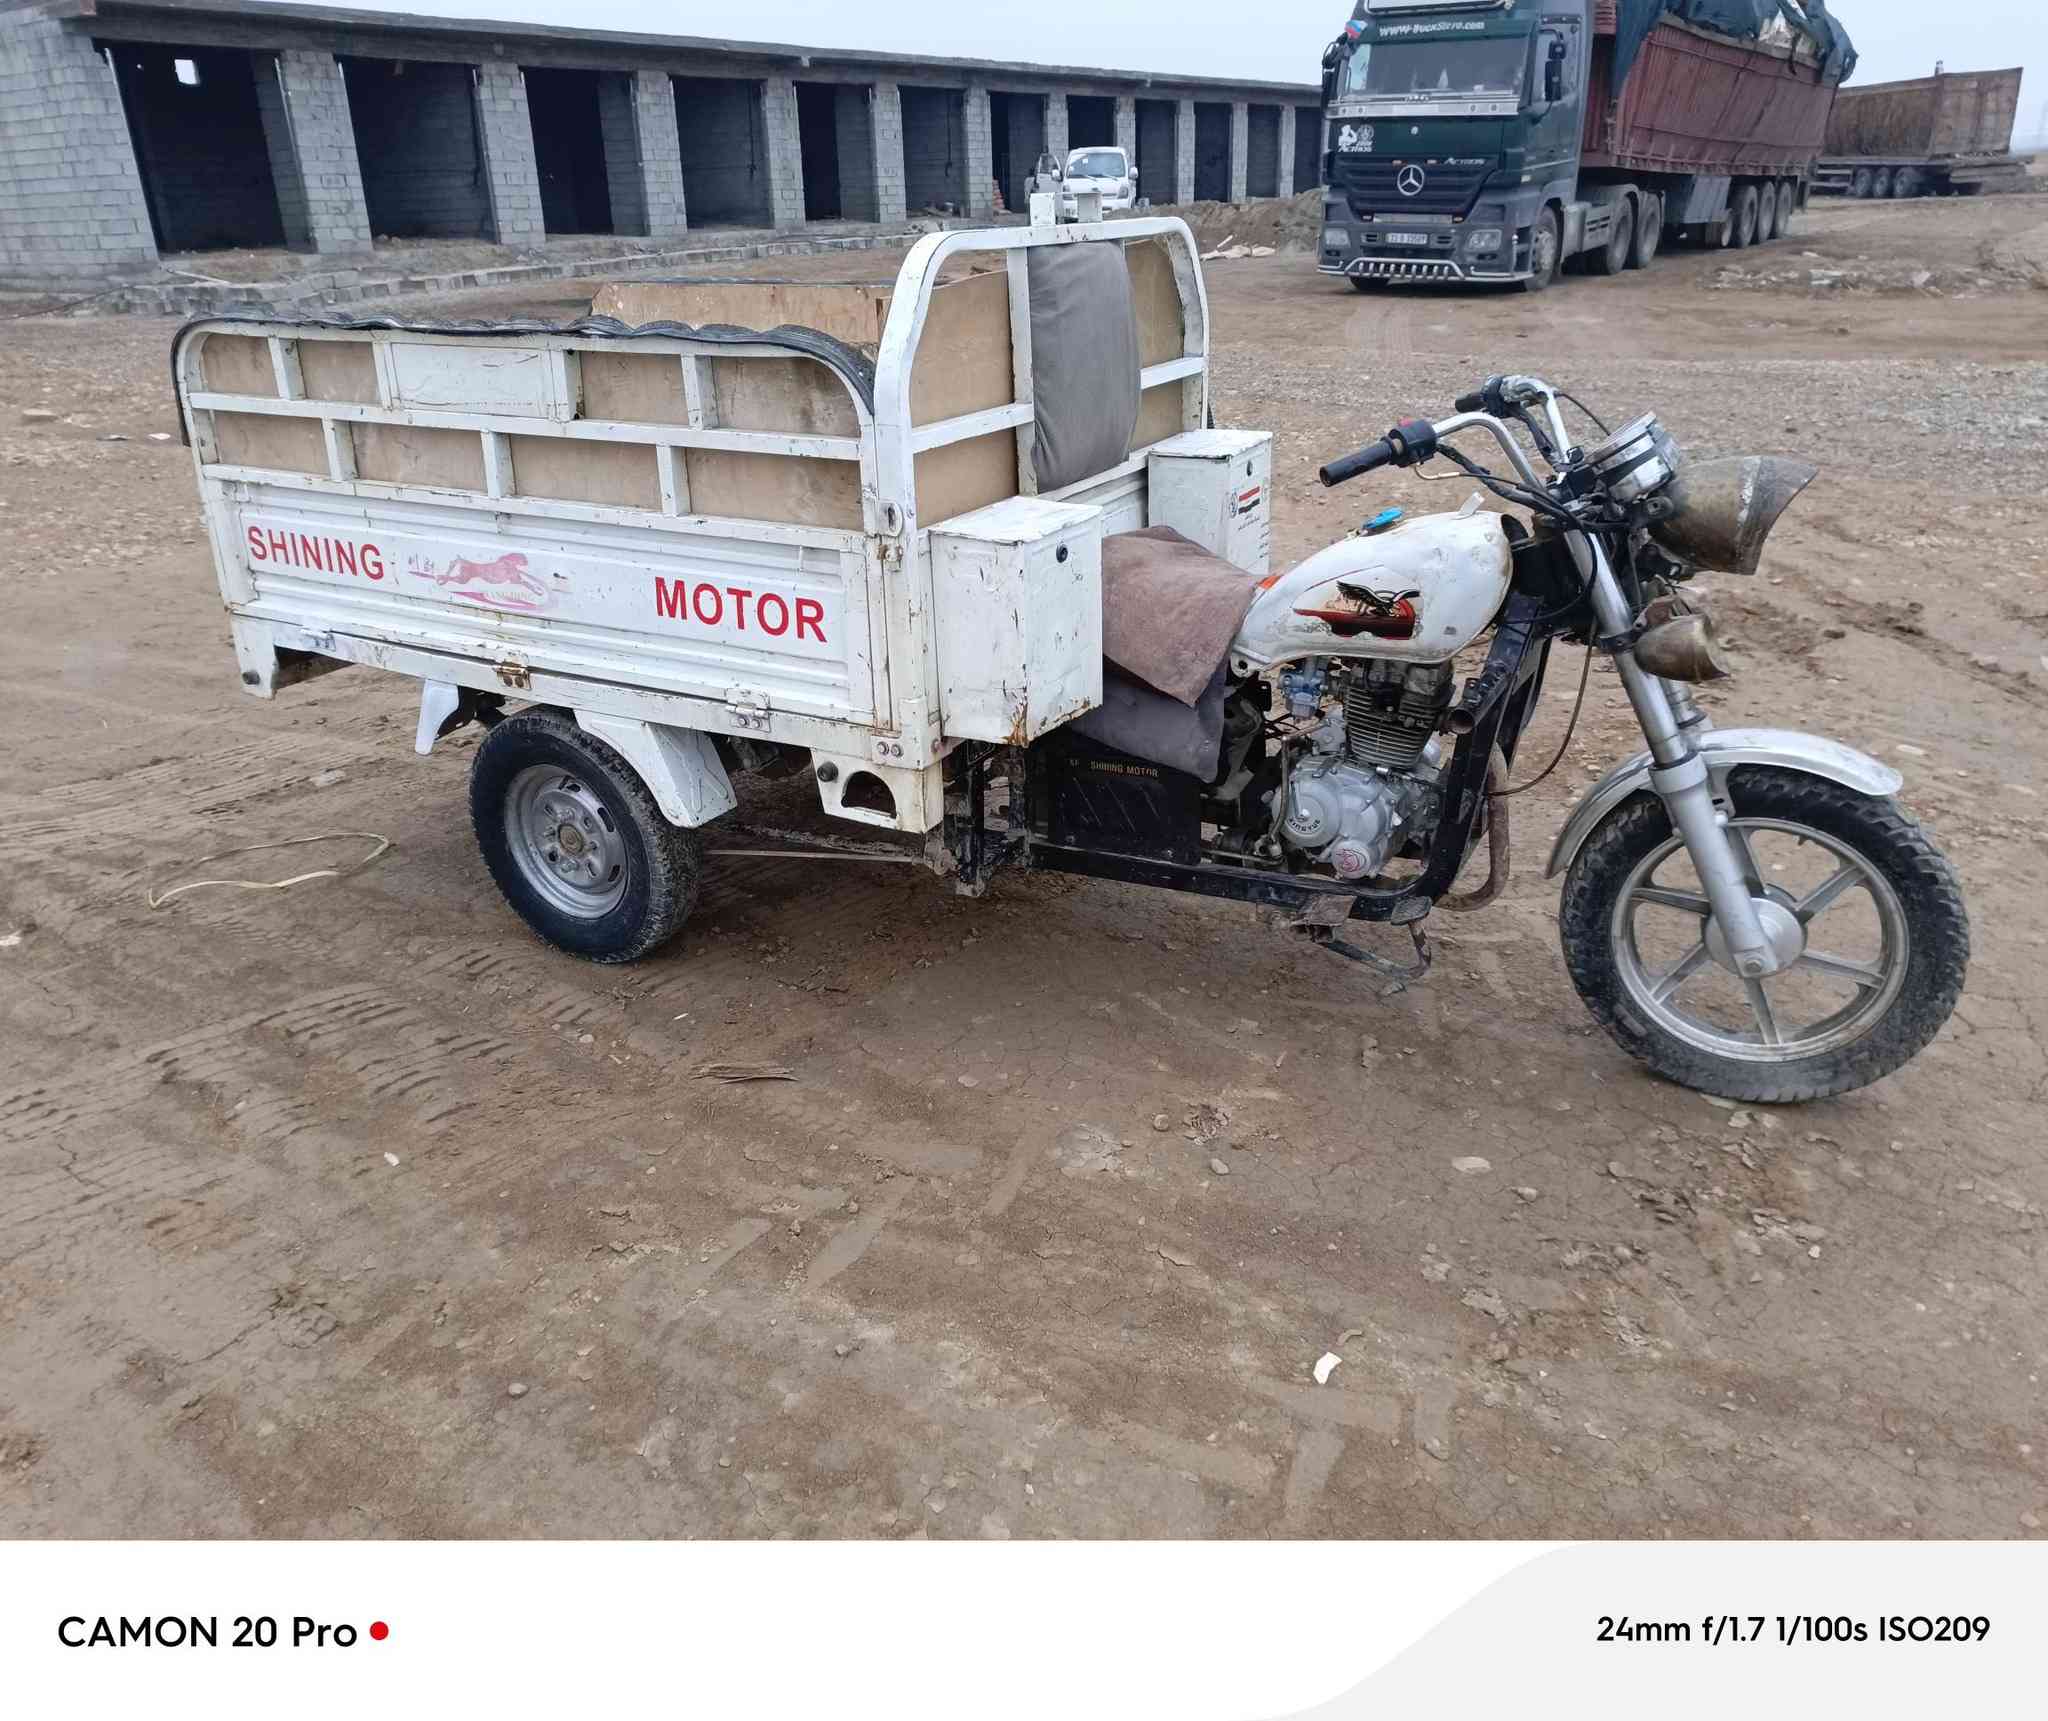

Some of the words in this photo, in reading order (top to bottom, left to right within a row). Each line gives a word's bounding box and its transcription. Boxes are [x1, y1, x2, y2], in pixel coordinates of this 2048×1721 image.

[247, 525, 385, 581] SHINING
[654, 576, 828, 643] MOTOR
[1126, 766, 1158, 777] MOTOR
